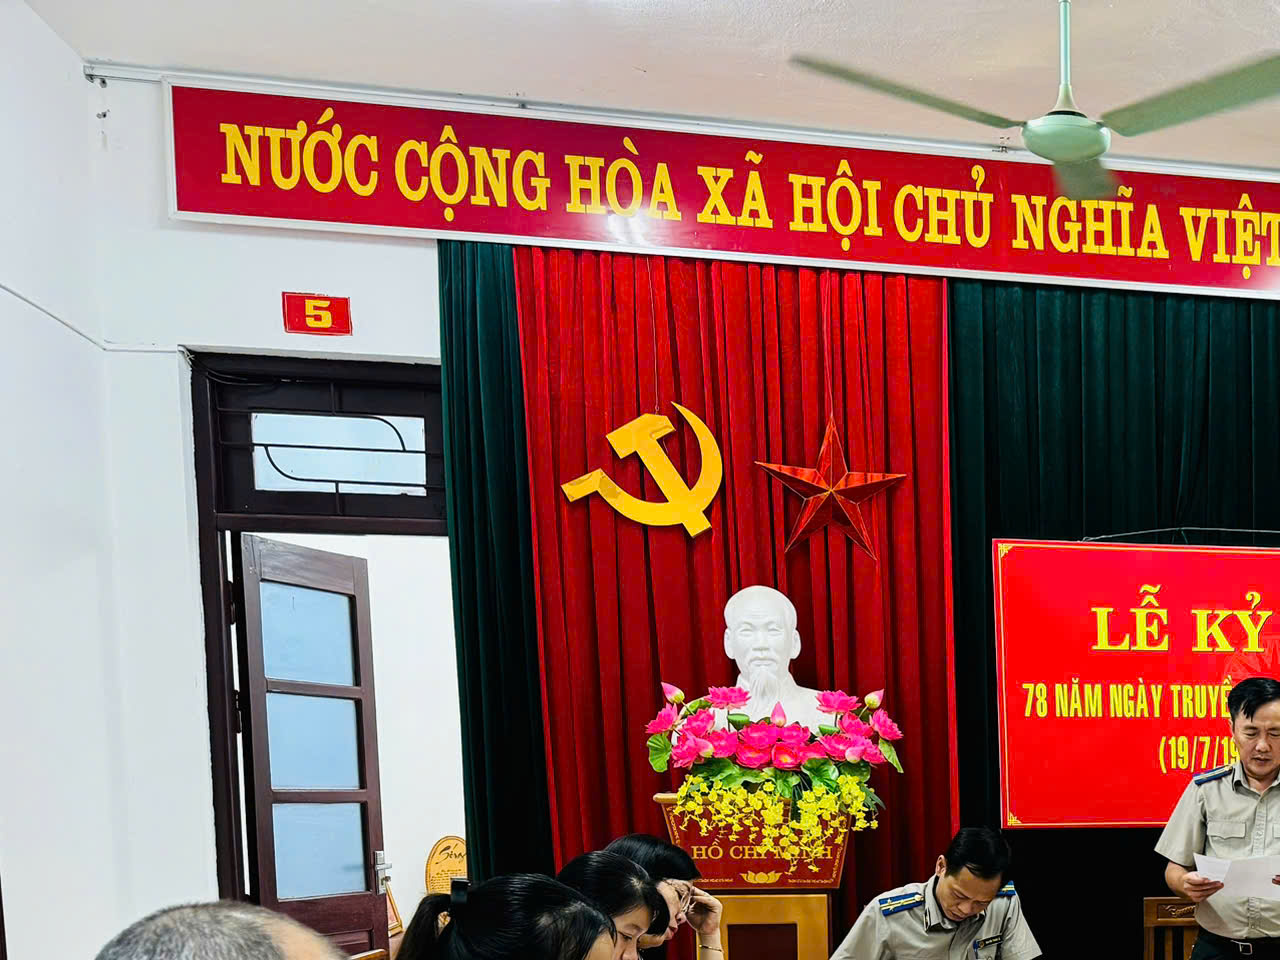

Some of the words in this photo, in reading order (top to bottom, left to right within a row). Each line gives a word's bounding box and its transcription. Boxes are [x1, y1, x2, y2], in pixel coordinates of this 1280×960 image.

[219, 107, 379, 197] NƯỚC
[394, 125, 551, 222] CỘNG
[564, 136, 682, 221] HÒA
[696, 150, 774, 229] XÃ
[788, 159, 883, 252] HỘI
[893, 164, 994, 249] CHỦ
[1011, 185, 1170, 260] NGHĨA
[304, 299, 333, 329] 5
[1091, 583, 1169, 652] LỄ
[1191, 591, 1273, 653] KỶ
[1021, 682, 1048, 719] 78
[1054, 677, 1104, 719] NĂM
[1109, 677, 1163, 719] NGÀY
[1170, 675, 1234, 719] TRUYỀ
